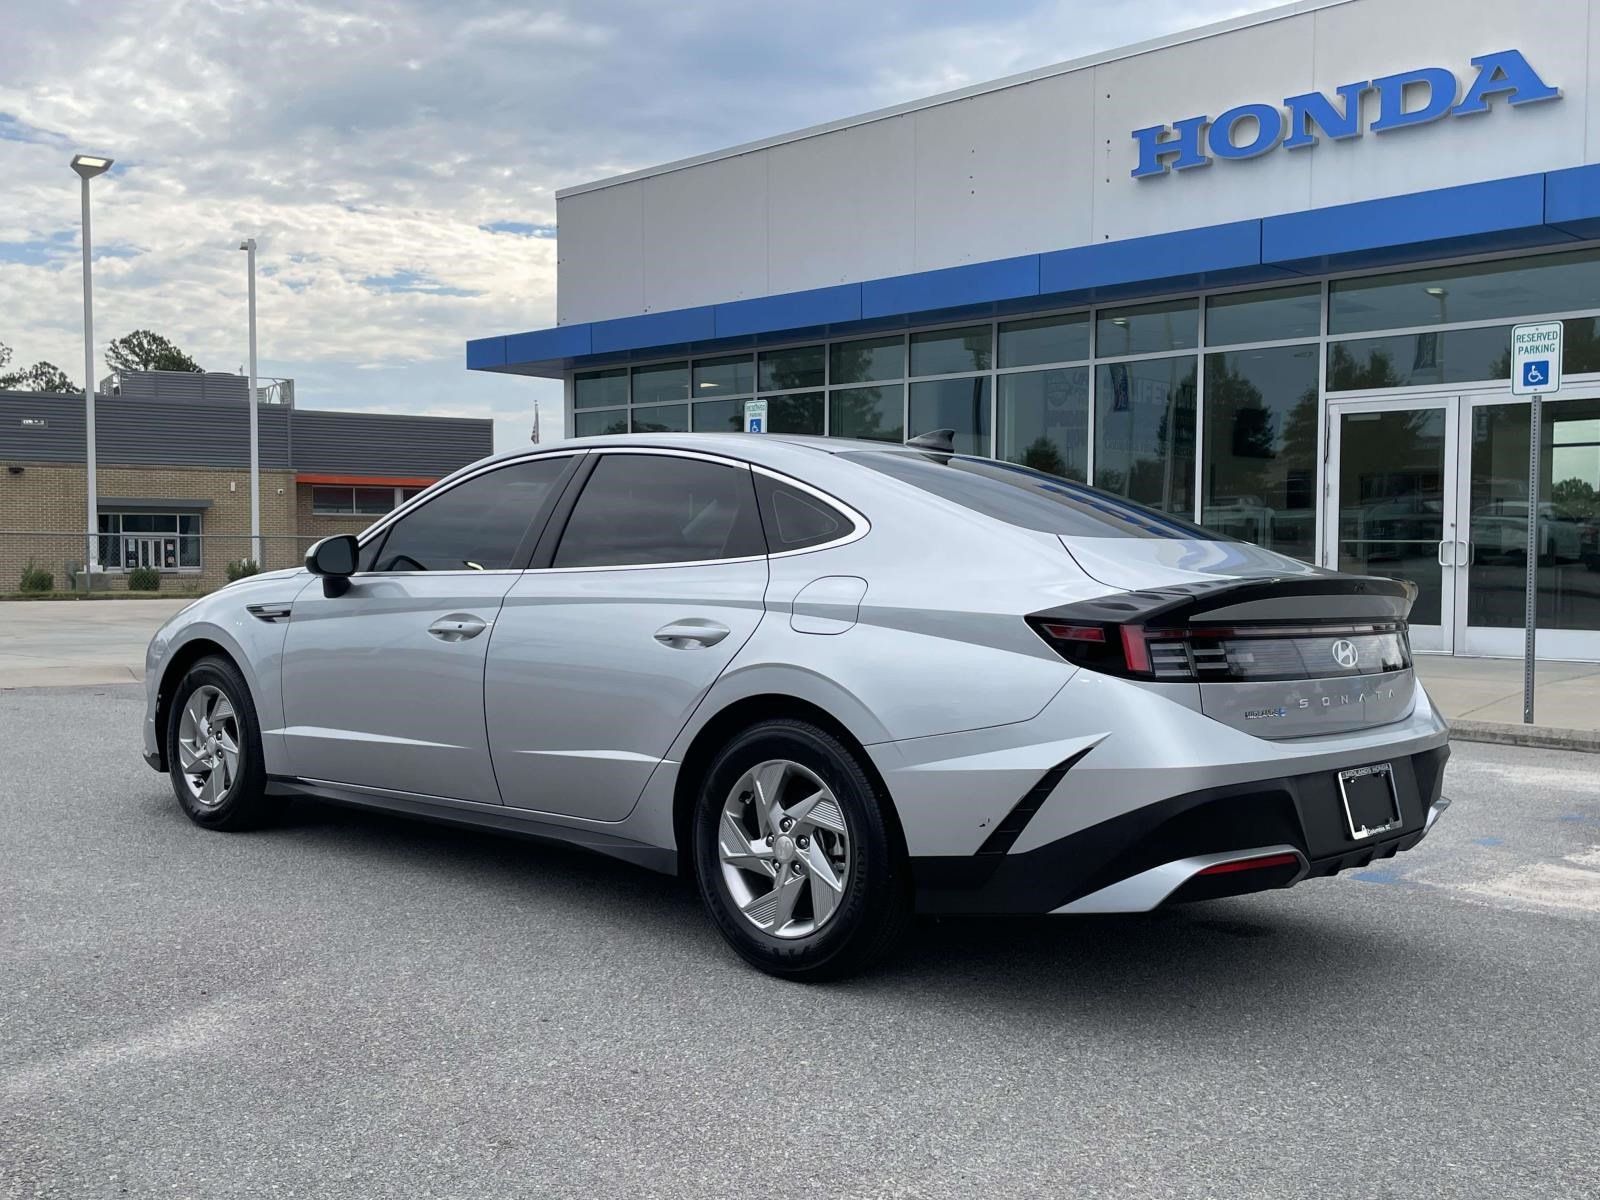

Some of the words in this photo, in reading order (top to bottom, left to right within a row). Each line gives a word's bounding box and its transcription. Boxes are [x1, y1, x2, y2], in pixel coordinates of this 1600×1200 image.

[1131, 49, 1563, 178] HONDA
[1516, 331, 1558, 343] RESERVED
[1518, 343, 1555, 355] PARKING
[1299, 689, 1395, 709] SONATA
